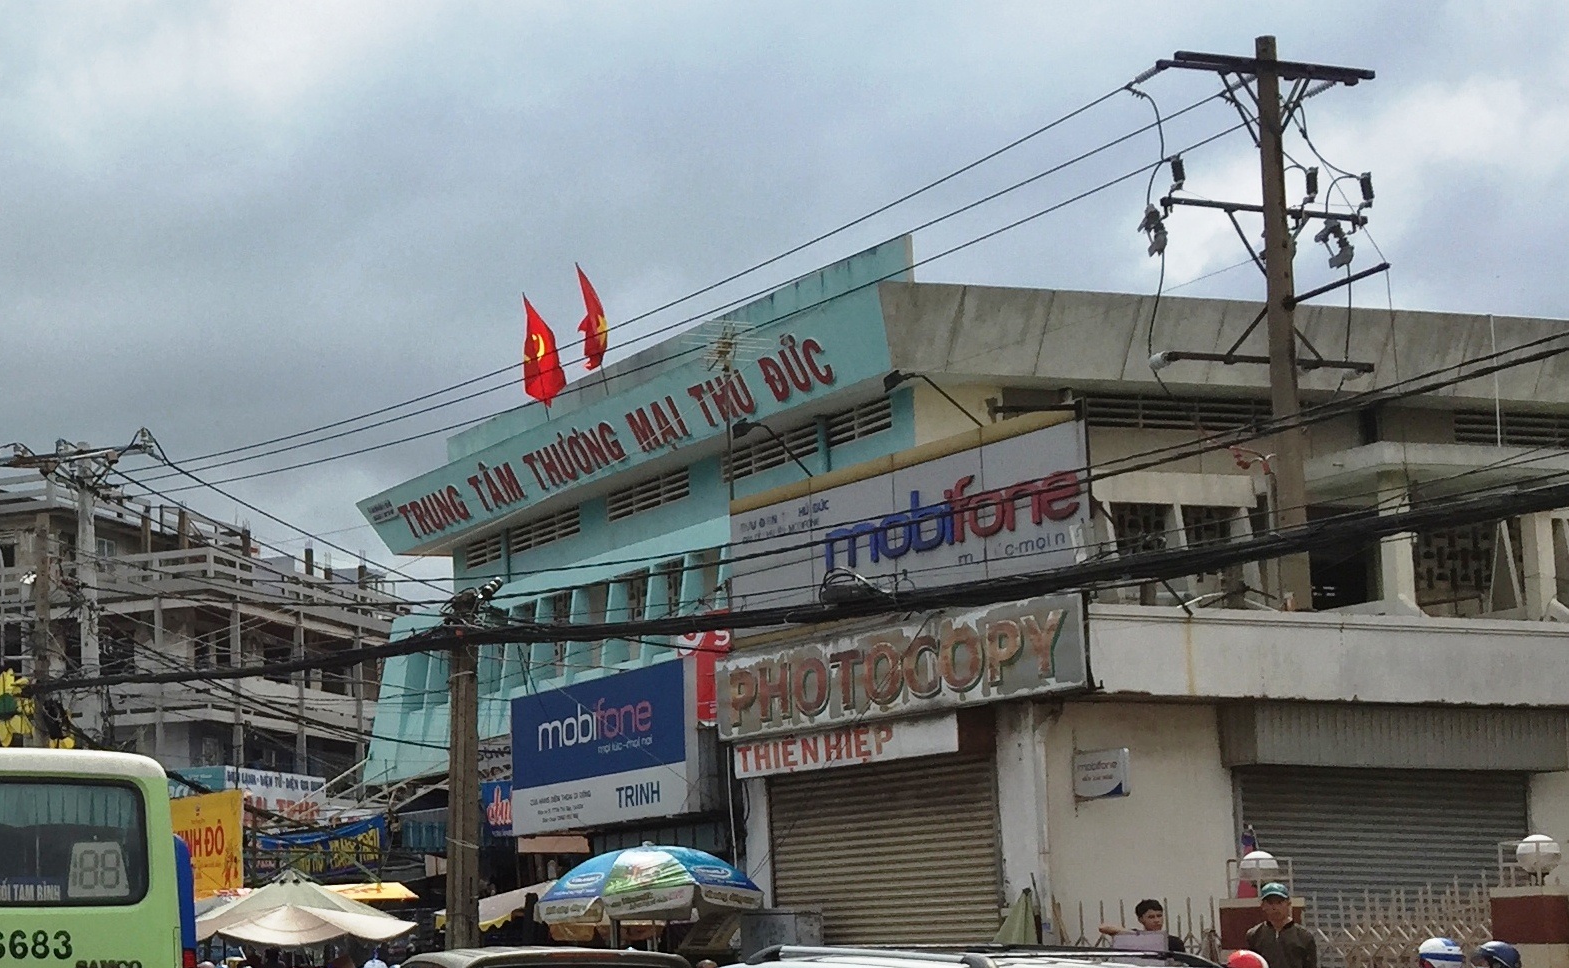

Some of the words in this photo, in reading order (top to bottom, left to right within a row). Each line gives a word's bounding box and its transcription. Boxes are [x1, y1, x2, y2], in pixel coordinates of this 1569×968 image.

[398, 485, 471, 539] TRUNG
[468, 463, 527, 512] TÂM
[523, 422, 626, 491] THƯƠNG
[625, 396, 692, 451] MẠI
[688, 367, 759, 428] THỦ
[758, 334, 835, 402] ĐỨC
[825, 471, 1081, 571] mobifone
[730, 609, 1067, 728] PHOTOCOPY
[538, 697, 653, 752] mobifone
[737, 731, 821, 773] THIỆN
[826, 722, 895, 765] HIỆP
[616, 780, 660, 808] TRINH
[204, 818, 224, 857] ĐÔ
